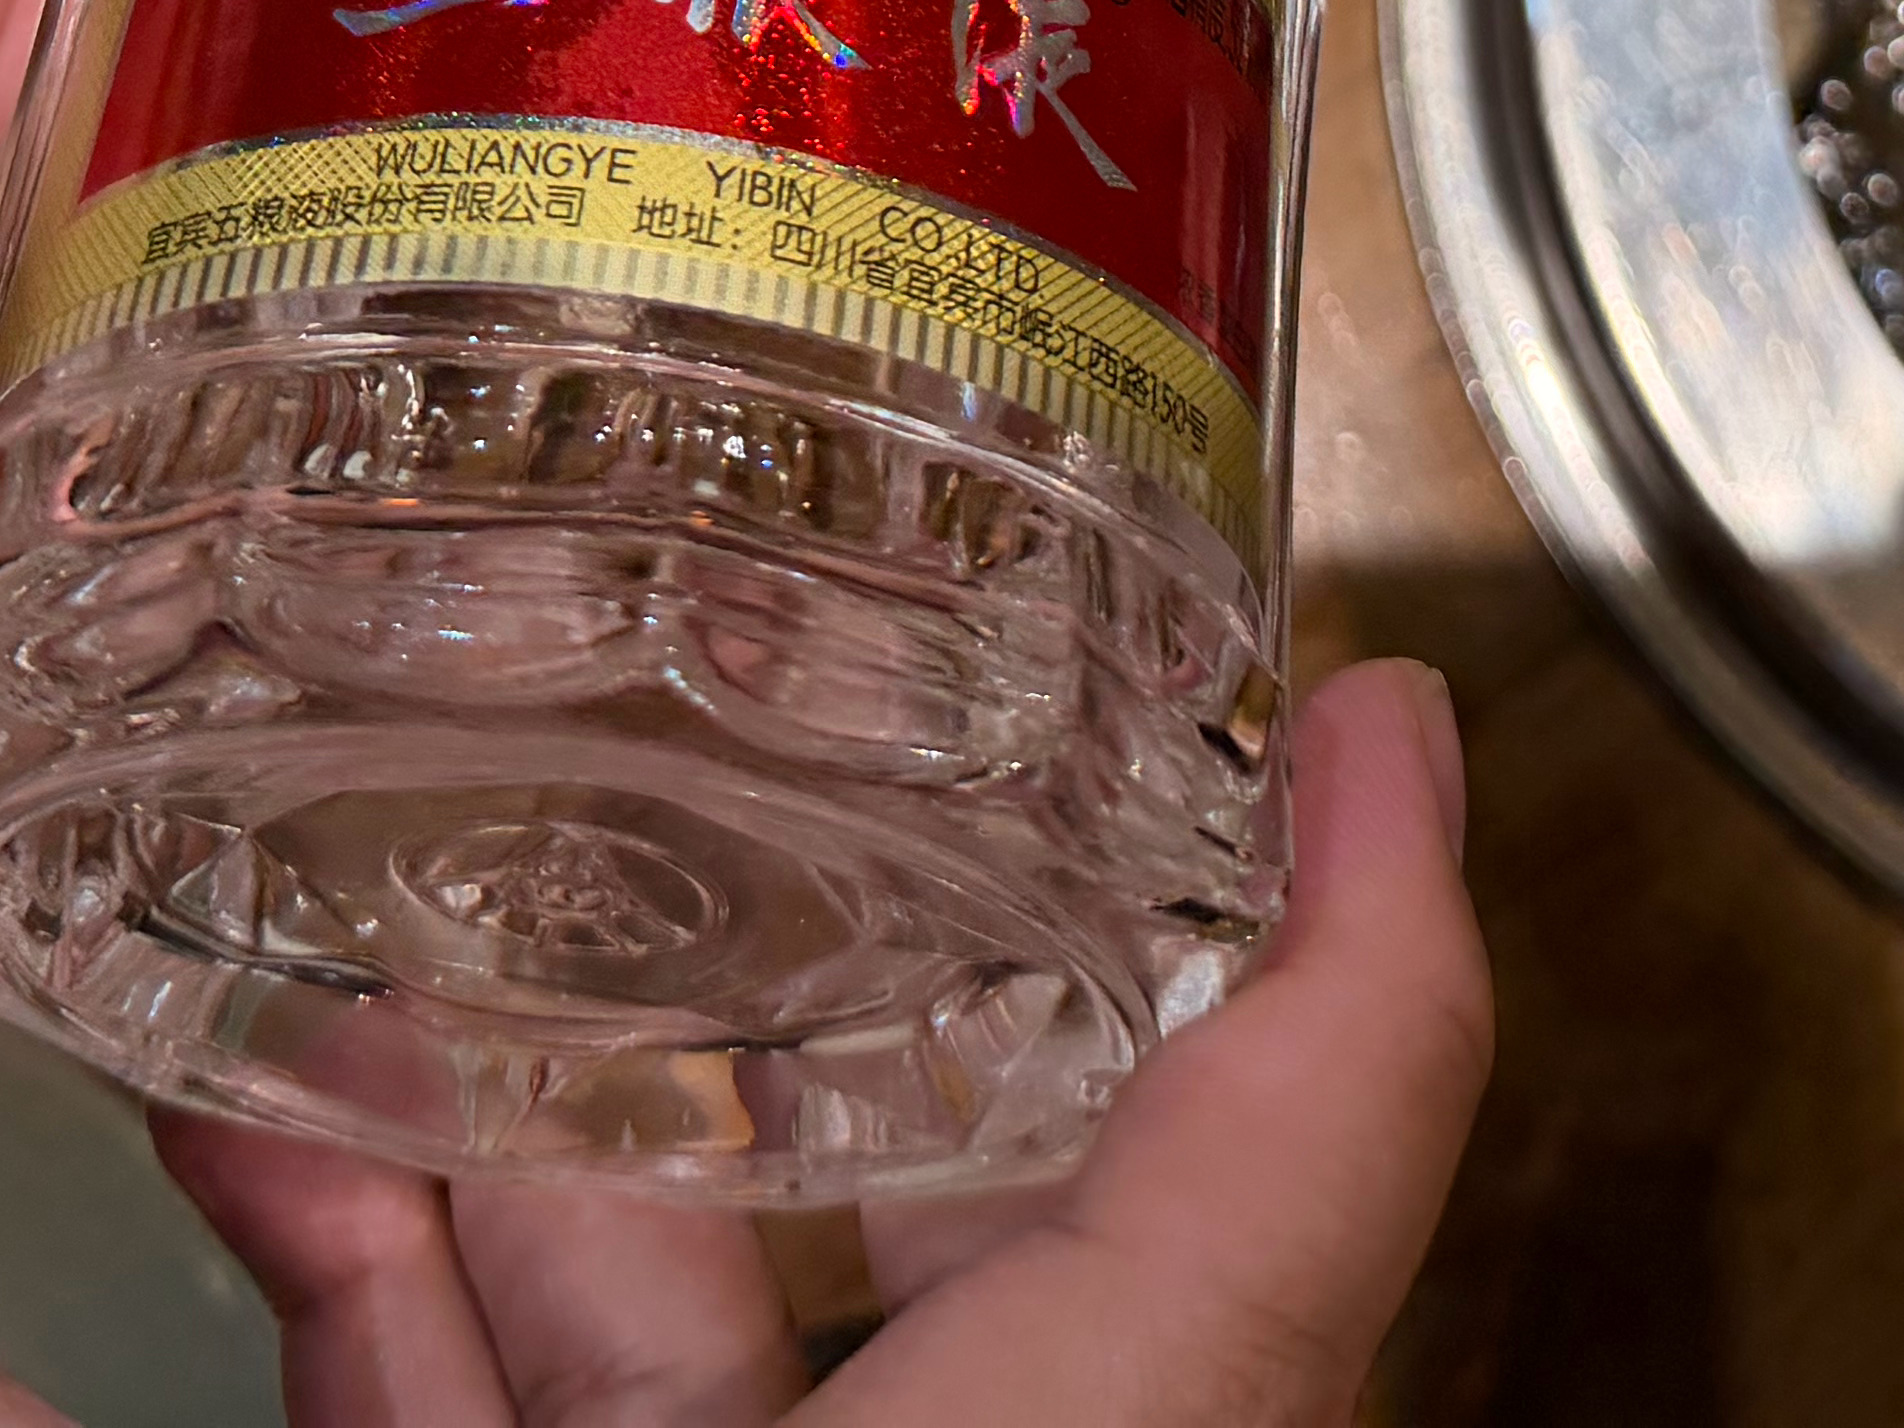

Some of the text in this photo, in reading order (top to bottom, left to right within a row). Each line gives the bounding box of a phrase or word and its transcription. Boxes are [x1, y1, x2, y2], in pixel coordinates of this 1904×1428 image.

[375, 137, 638, 185] WULIANGYE
[706, 159, 816, 218] YIBIN
[140, 182, 586, 265] 宜宾五粮液股份有限公司
